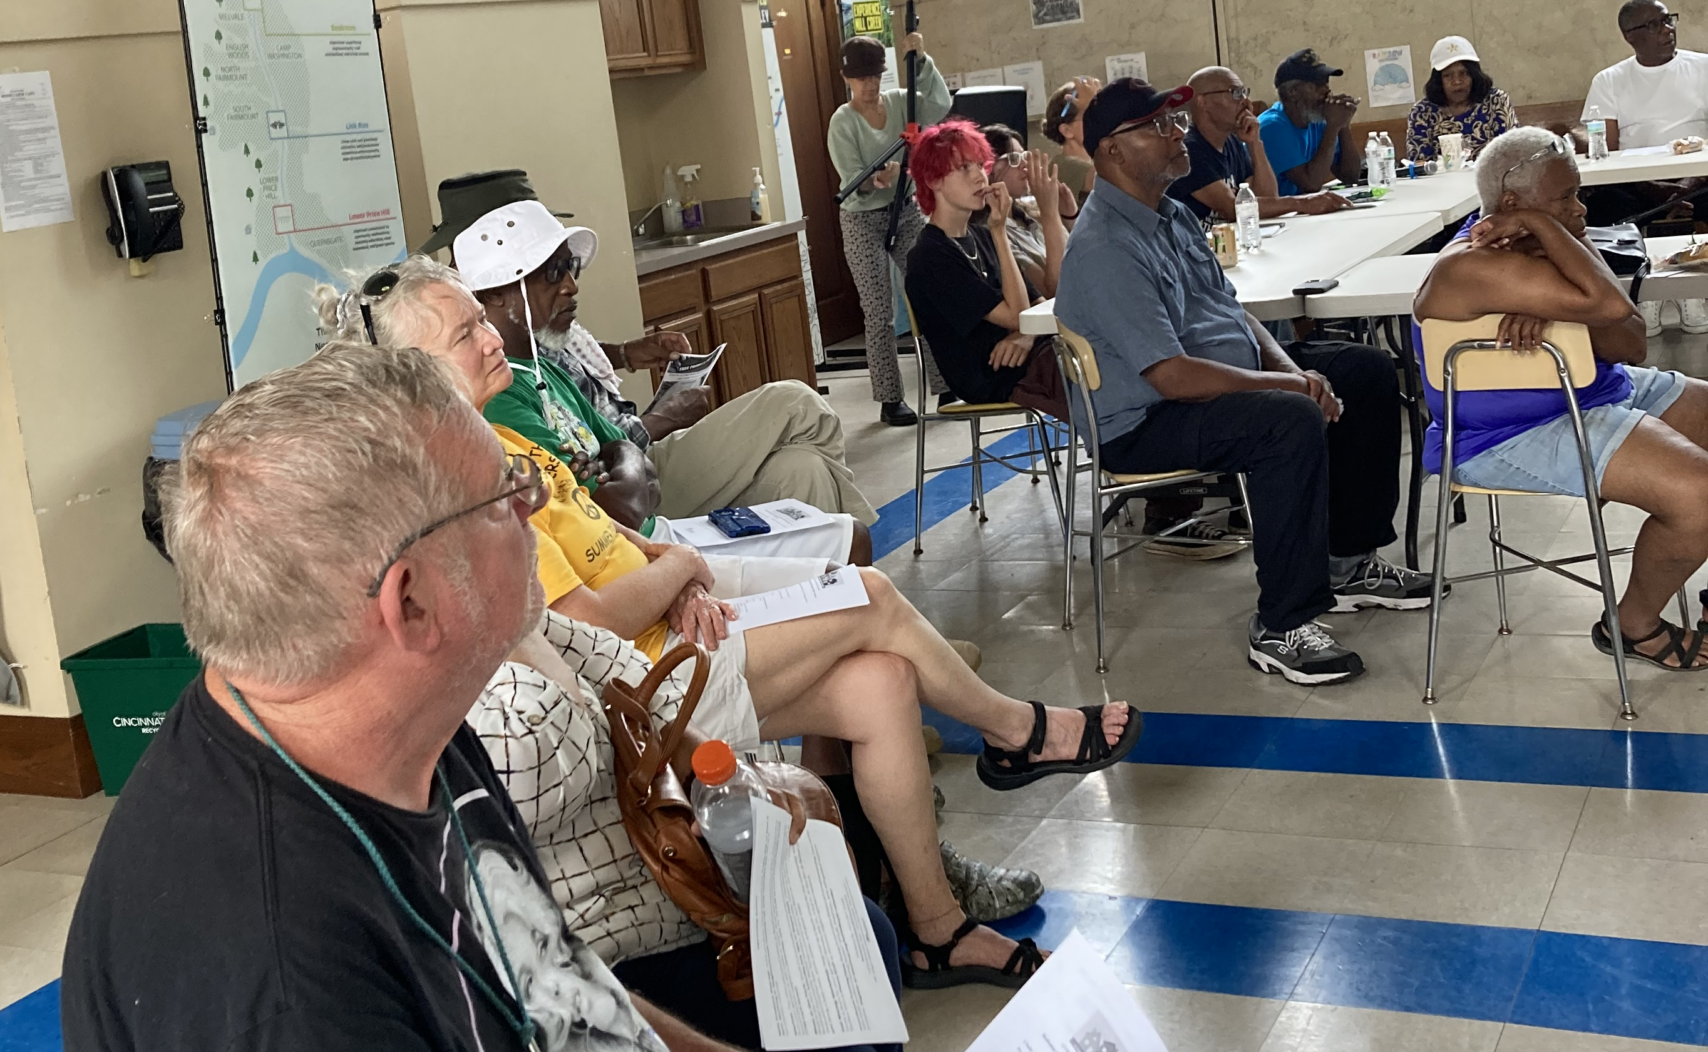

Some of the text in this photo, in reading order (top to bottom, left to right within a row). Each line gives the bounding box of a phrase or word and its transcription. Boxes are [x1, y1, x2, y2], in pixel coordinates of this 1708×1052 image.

[225, 43, 249, 52] ENGLISH
[275, 44, 292, 52] CAMP
[220, 65, 241, 74] NORTH
[232, 104, 252, 113] SOUTH
[259, 175, 279, 185] LOWER
[262, 184, 278, 193] PRICE
[366, 209, 381, 218] Price
